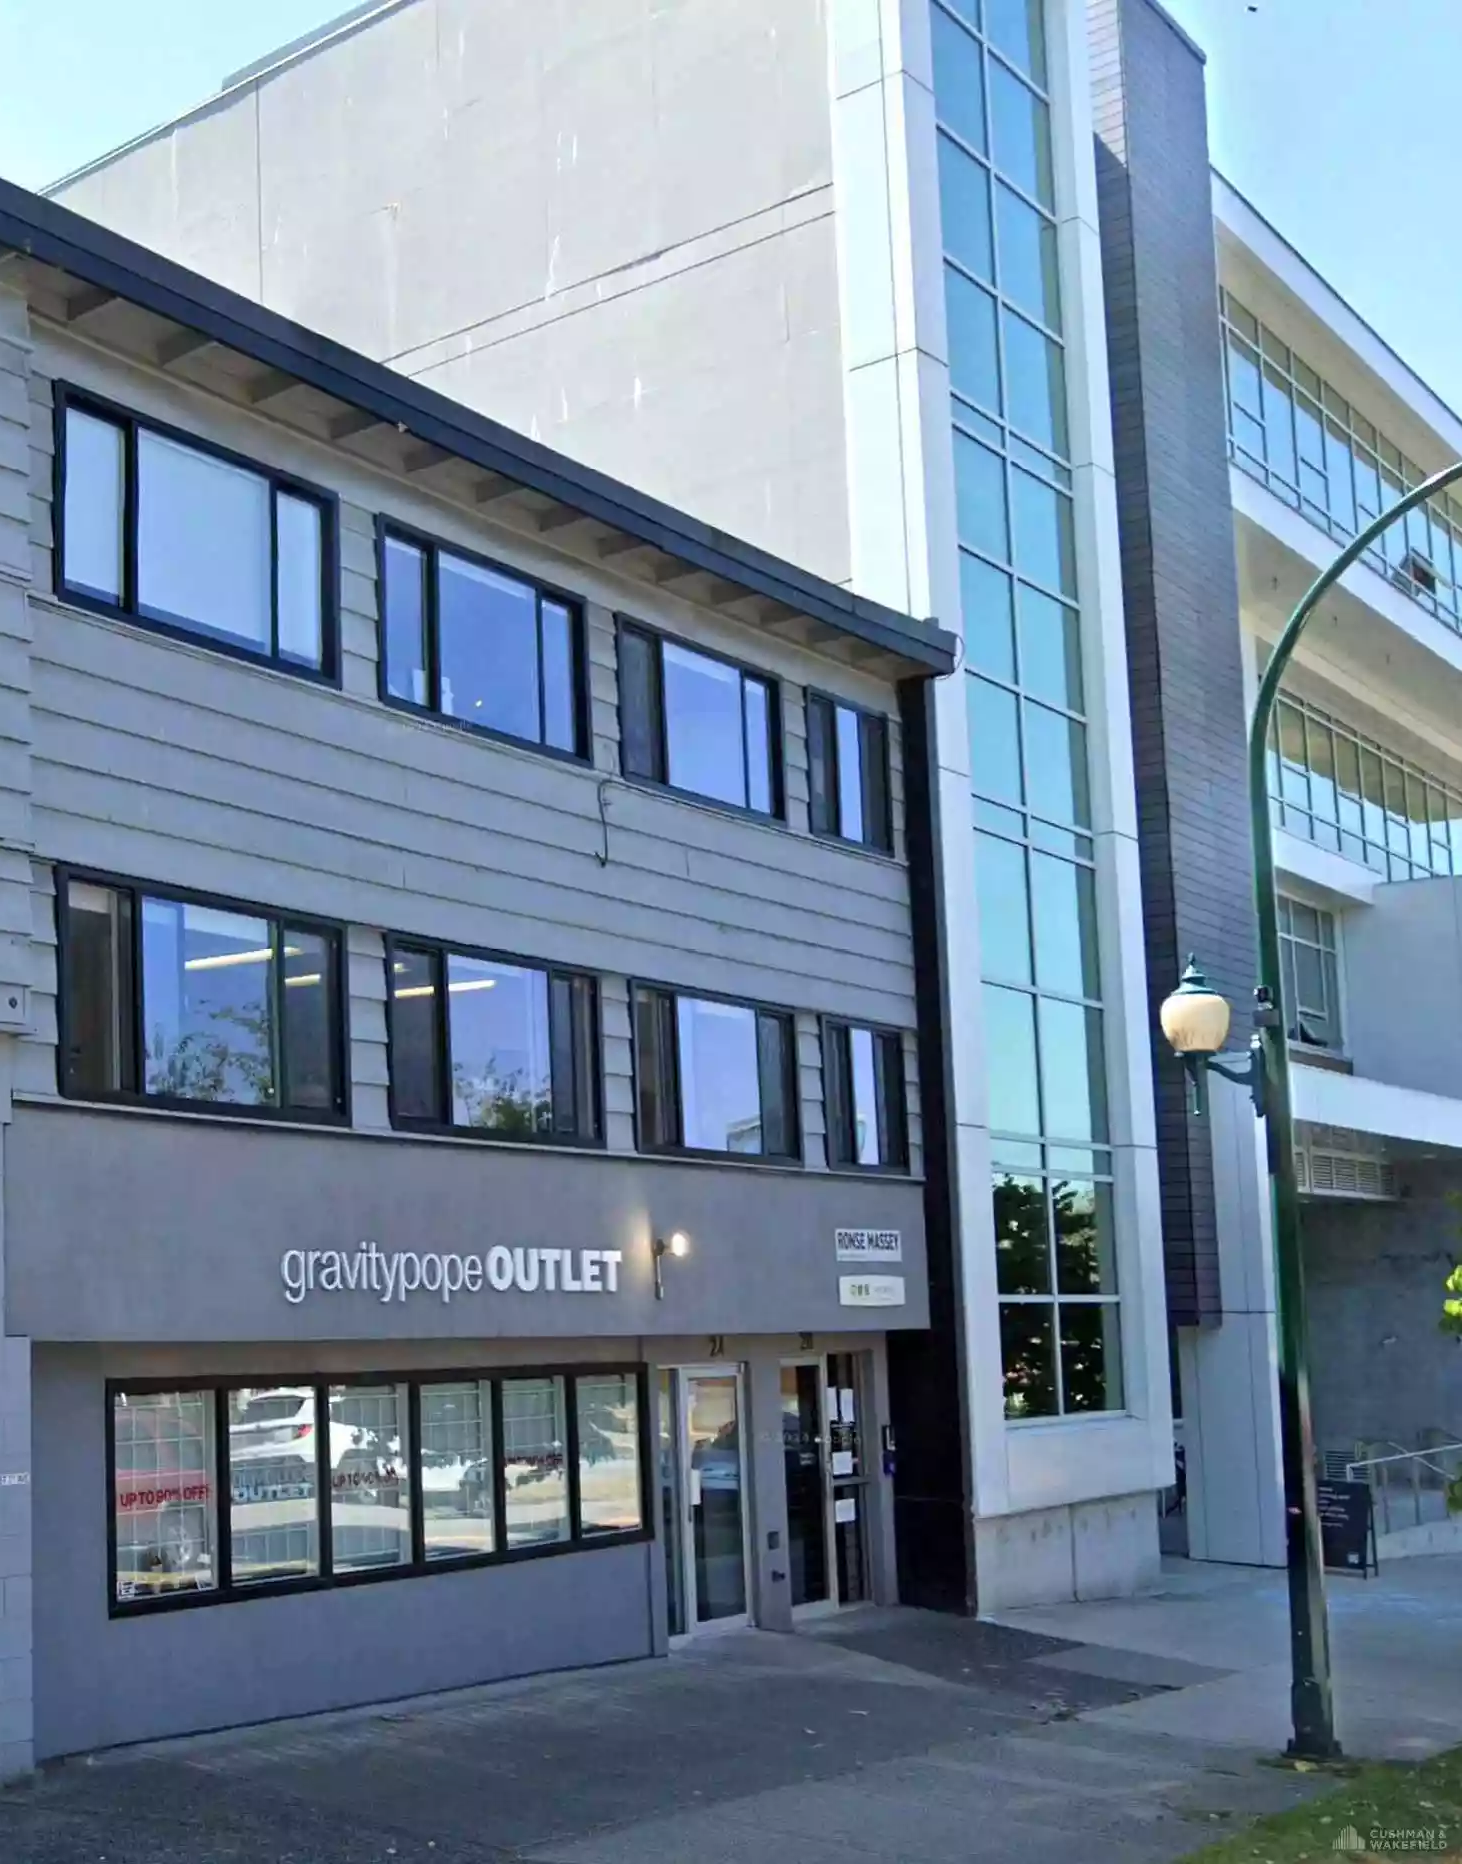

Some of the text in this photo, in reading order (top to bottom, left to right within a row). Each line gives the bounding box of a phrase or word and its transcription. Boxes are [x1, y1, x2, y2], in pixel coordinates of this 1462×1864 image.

[837, 1231, 899, 1252] RONSE MASSEY
[281, 1241, 623, 1304] gravitypope OUTLET
[119, 1491, 137, 1509] UP
[137, 1489, 155, 1506] TO
